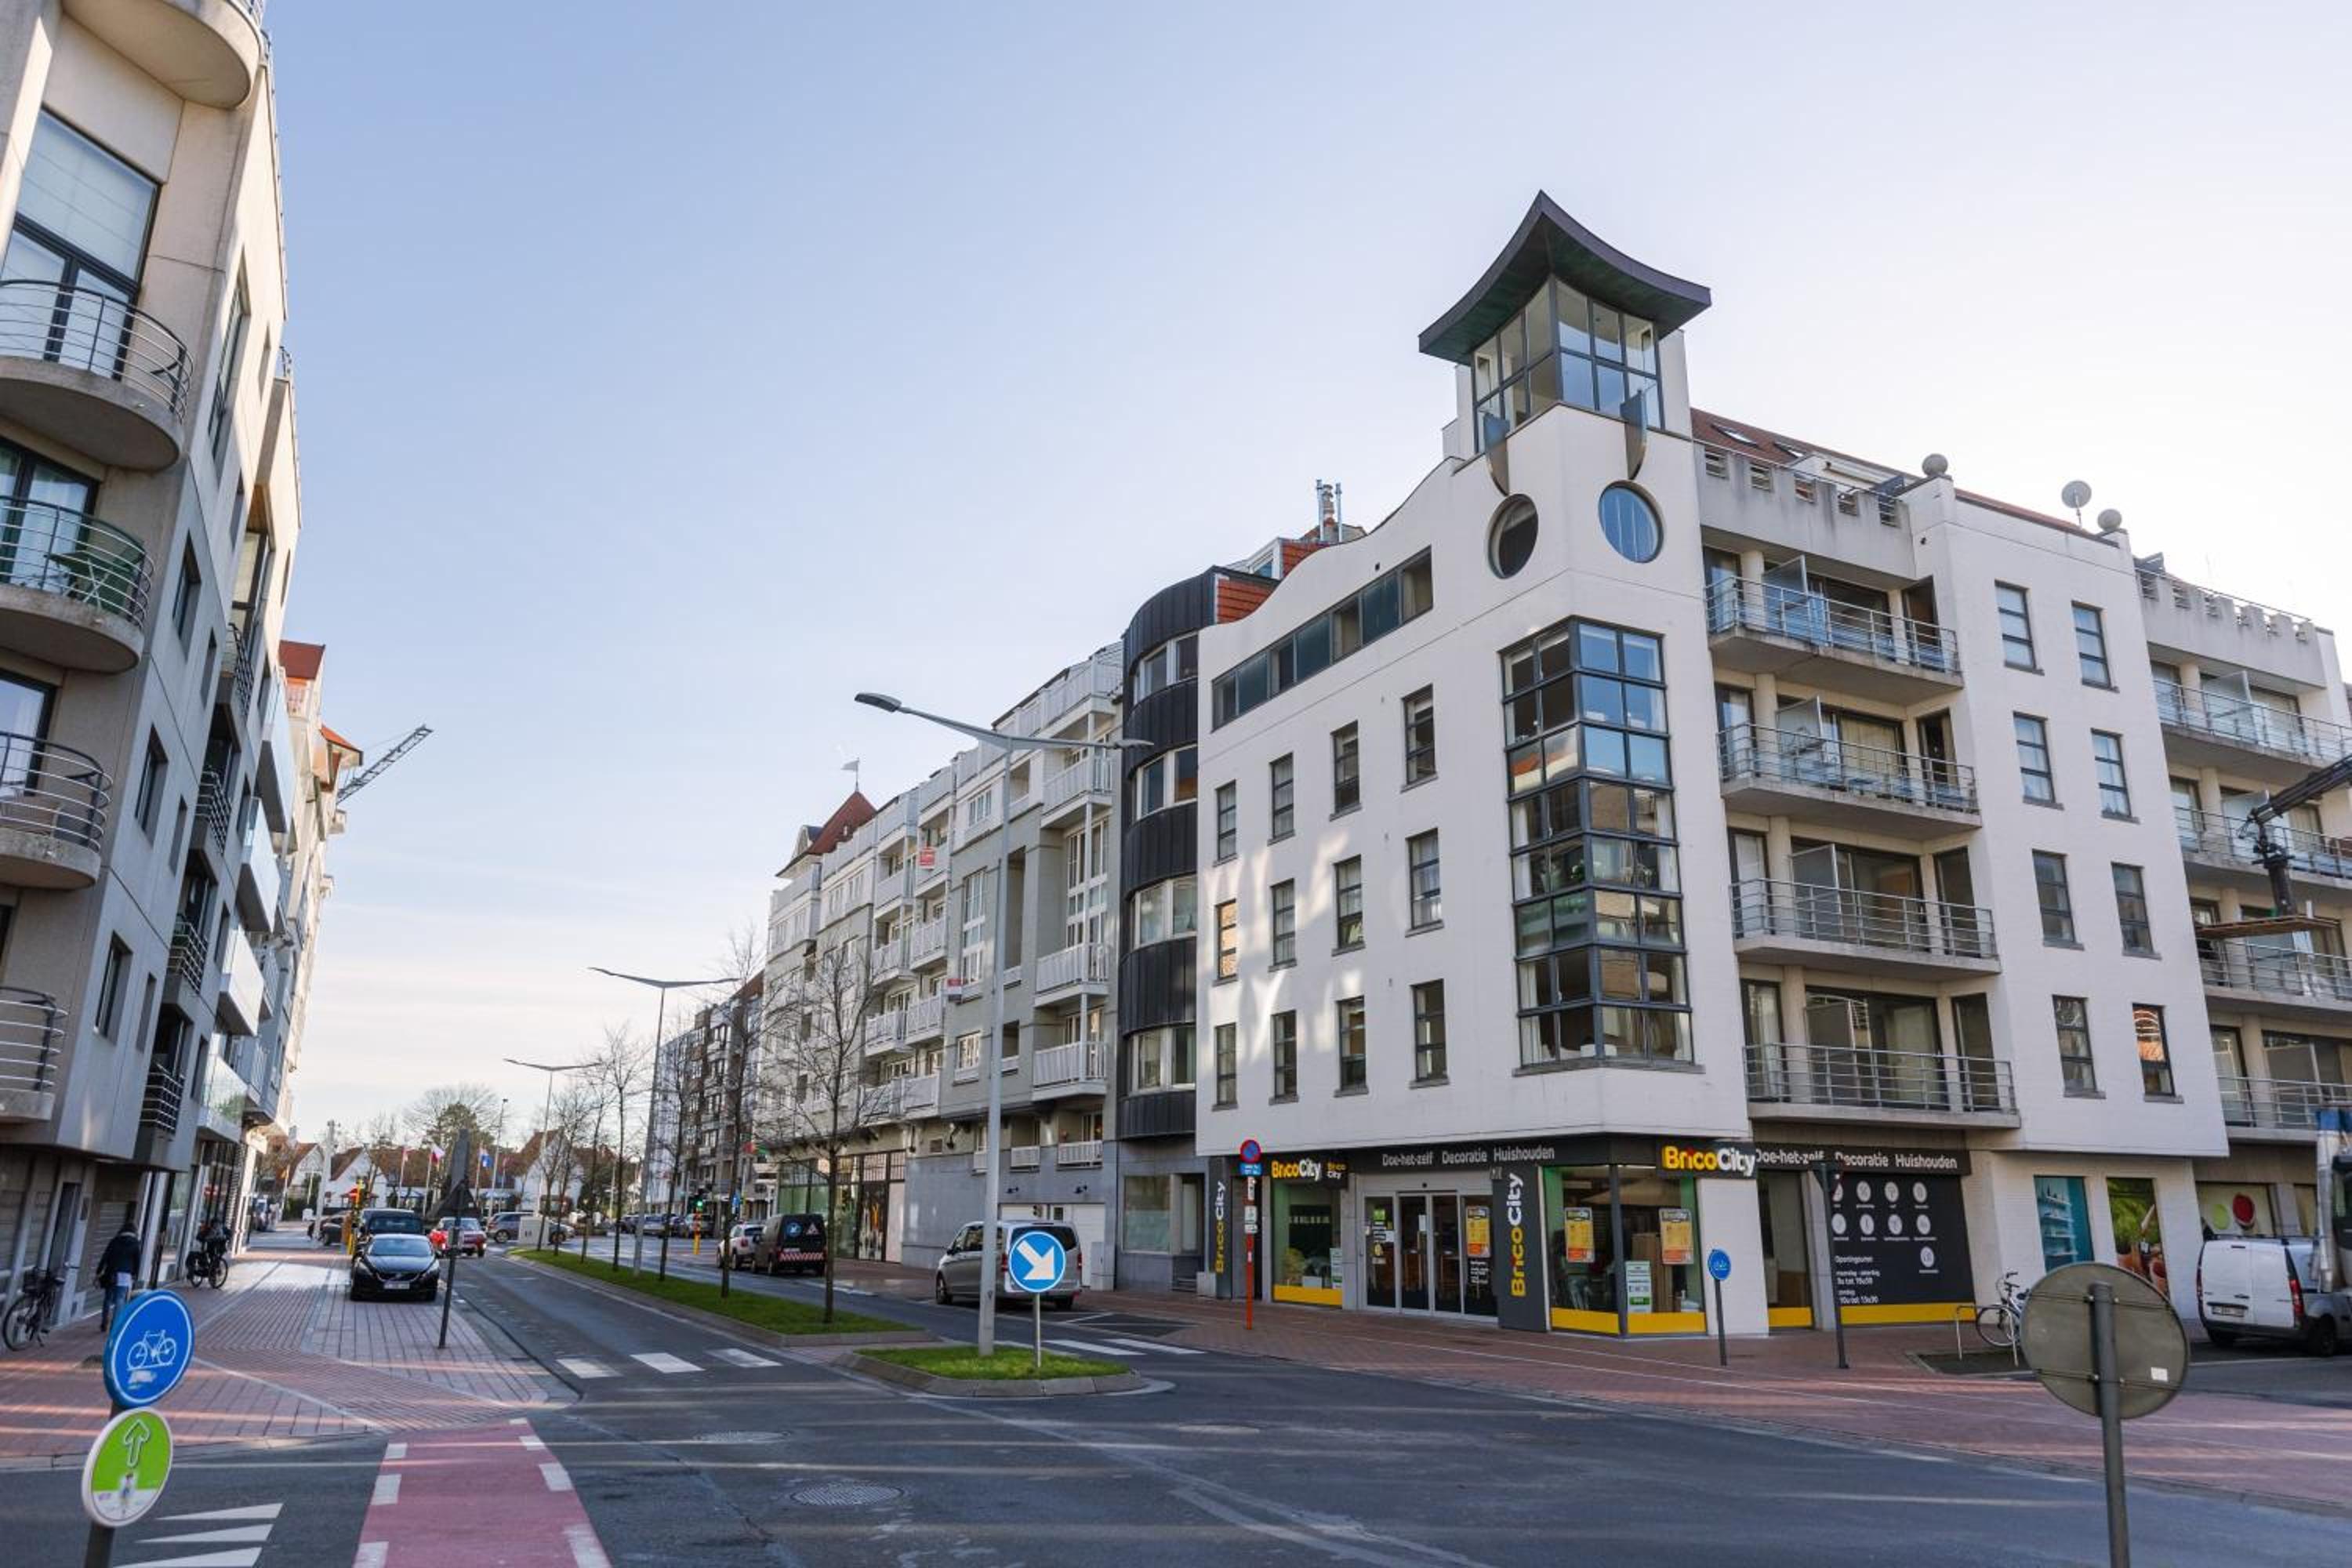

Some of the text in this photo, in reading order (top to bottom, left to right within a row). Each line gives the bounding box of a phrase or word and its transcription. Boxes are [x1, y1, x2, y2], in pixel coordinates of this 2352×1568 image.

[1382, 1144, 1555, 1166] Doe-het-zelf Decoratie Huishouden
[1662, 1145, 1755, 1177] BricoCity
[1895, 1154, 1958, 1169] Huishouden
[1272, 1159, 1322, 1181] BricoCity
[1215, 1181, 1225, 1273] BricoCity
[1507, 1173, 1526, 1297] BricoCity
